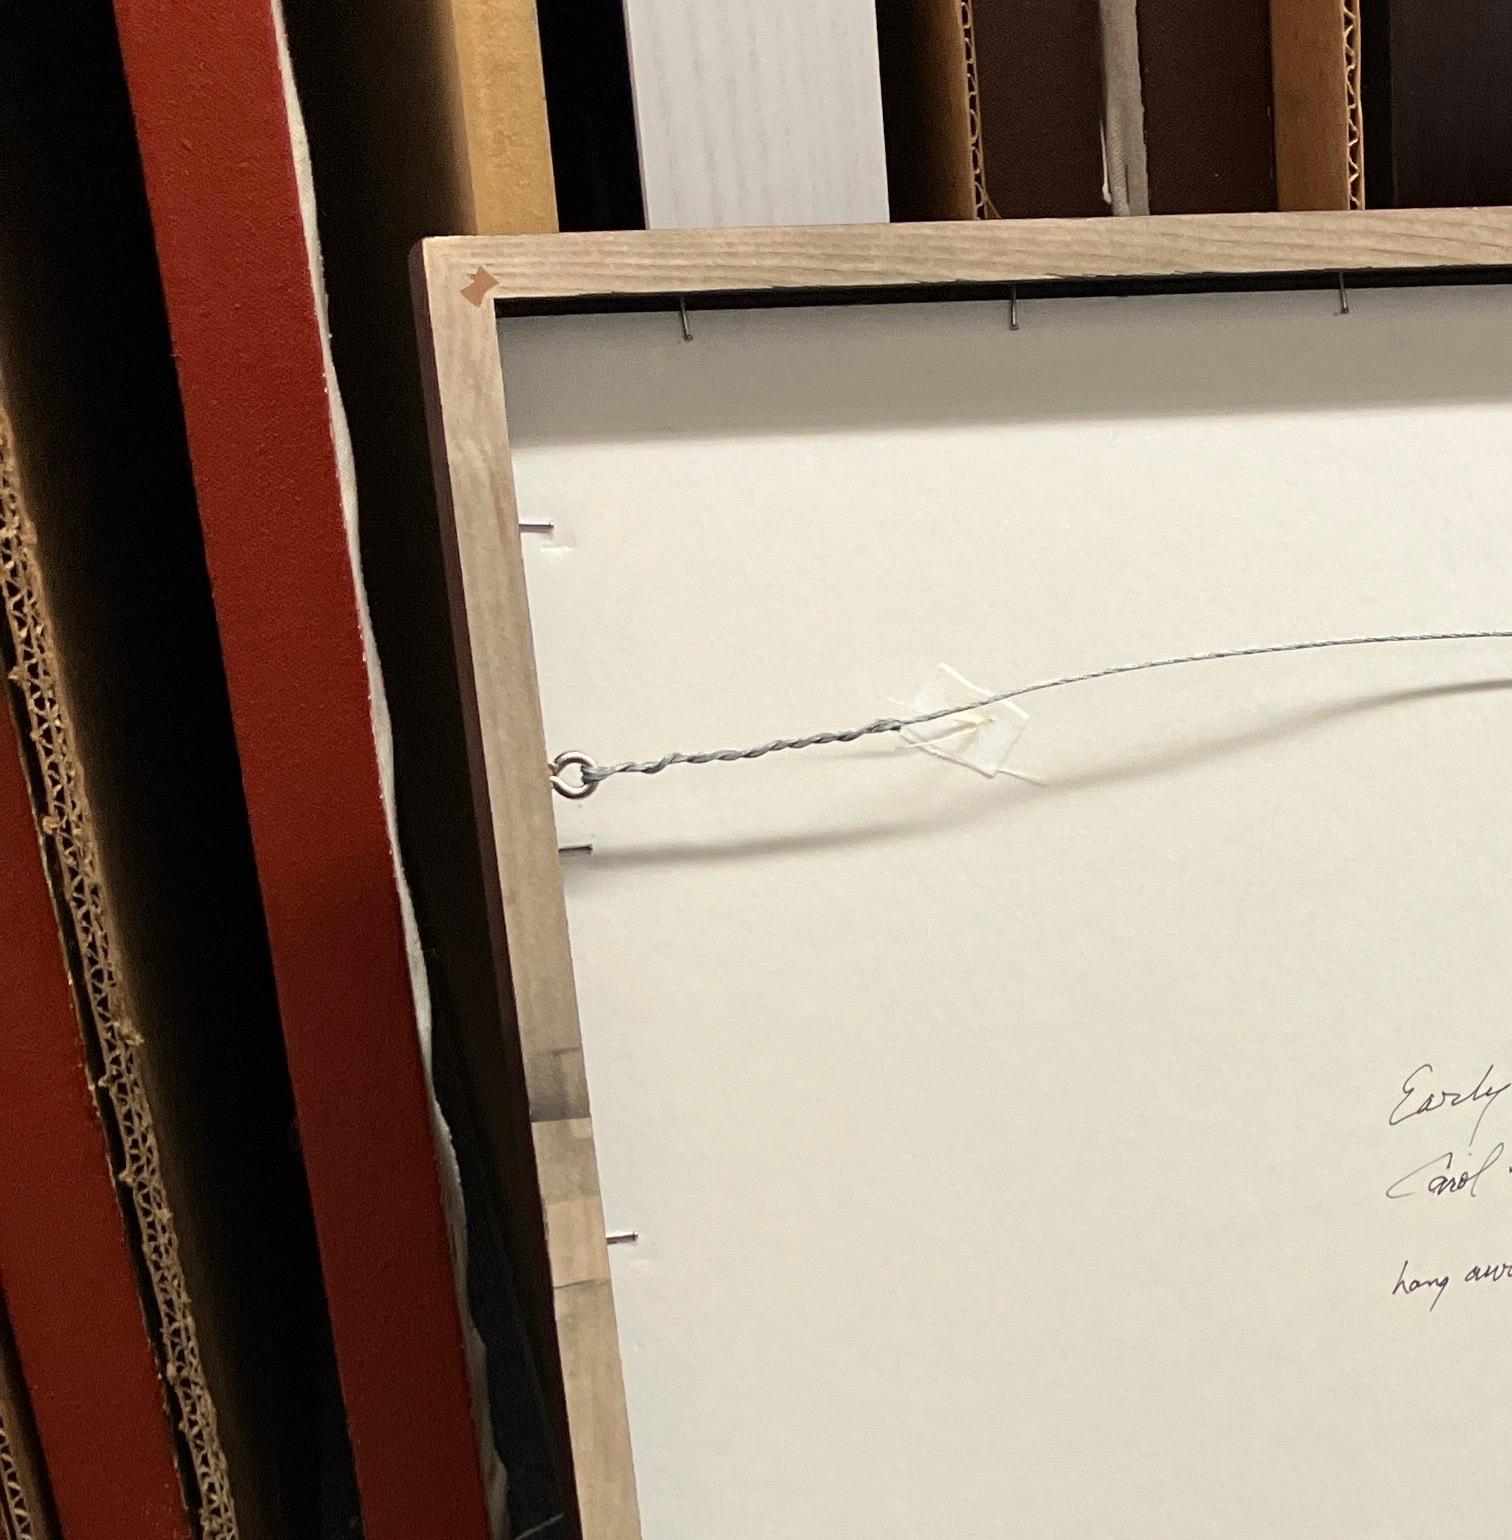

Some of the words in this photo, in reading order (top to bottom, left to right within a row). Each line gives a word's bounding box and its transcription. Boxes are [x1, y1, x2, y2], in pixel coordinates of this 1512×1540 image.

[1389, 1063, 1511, 1147] Early
[1386, 1142, 1504, 1199] Carol
[1392, 1260, 1449, 1312] hang
